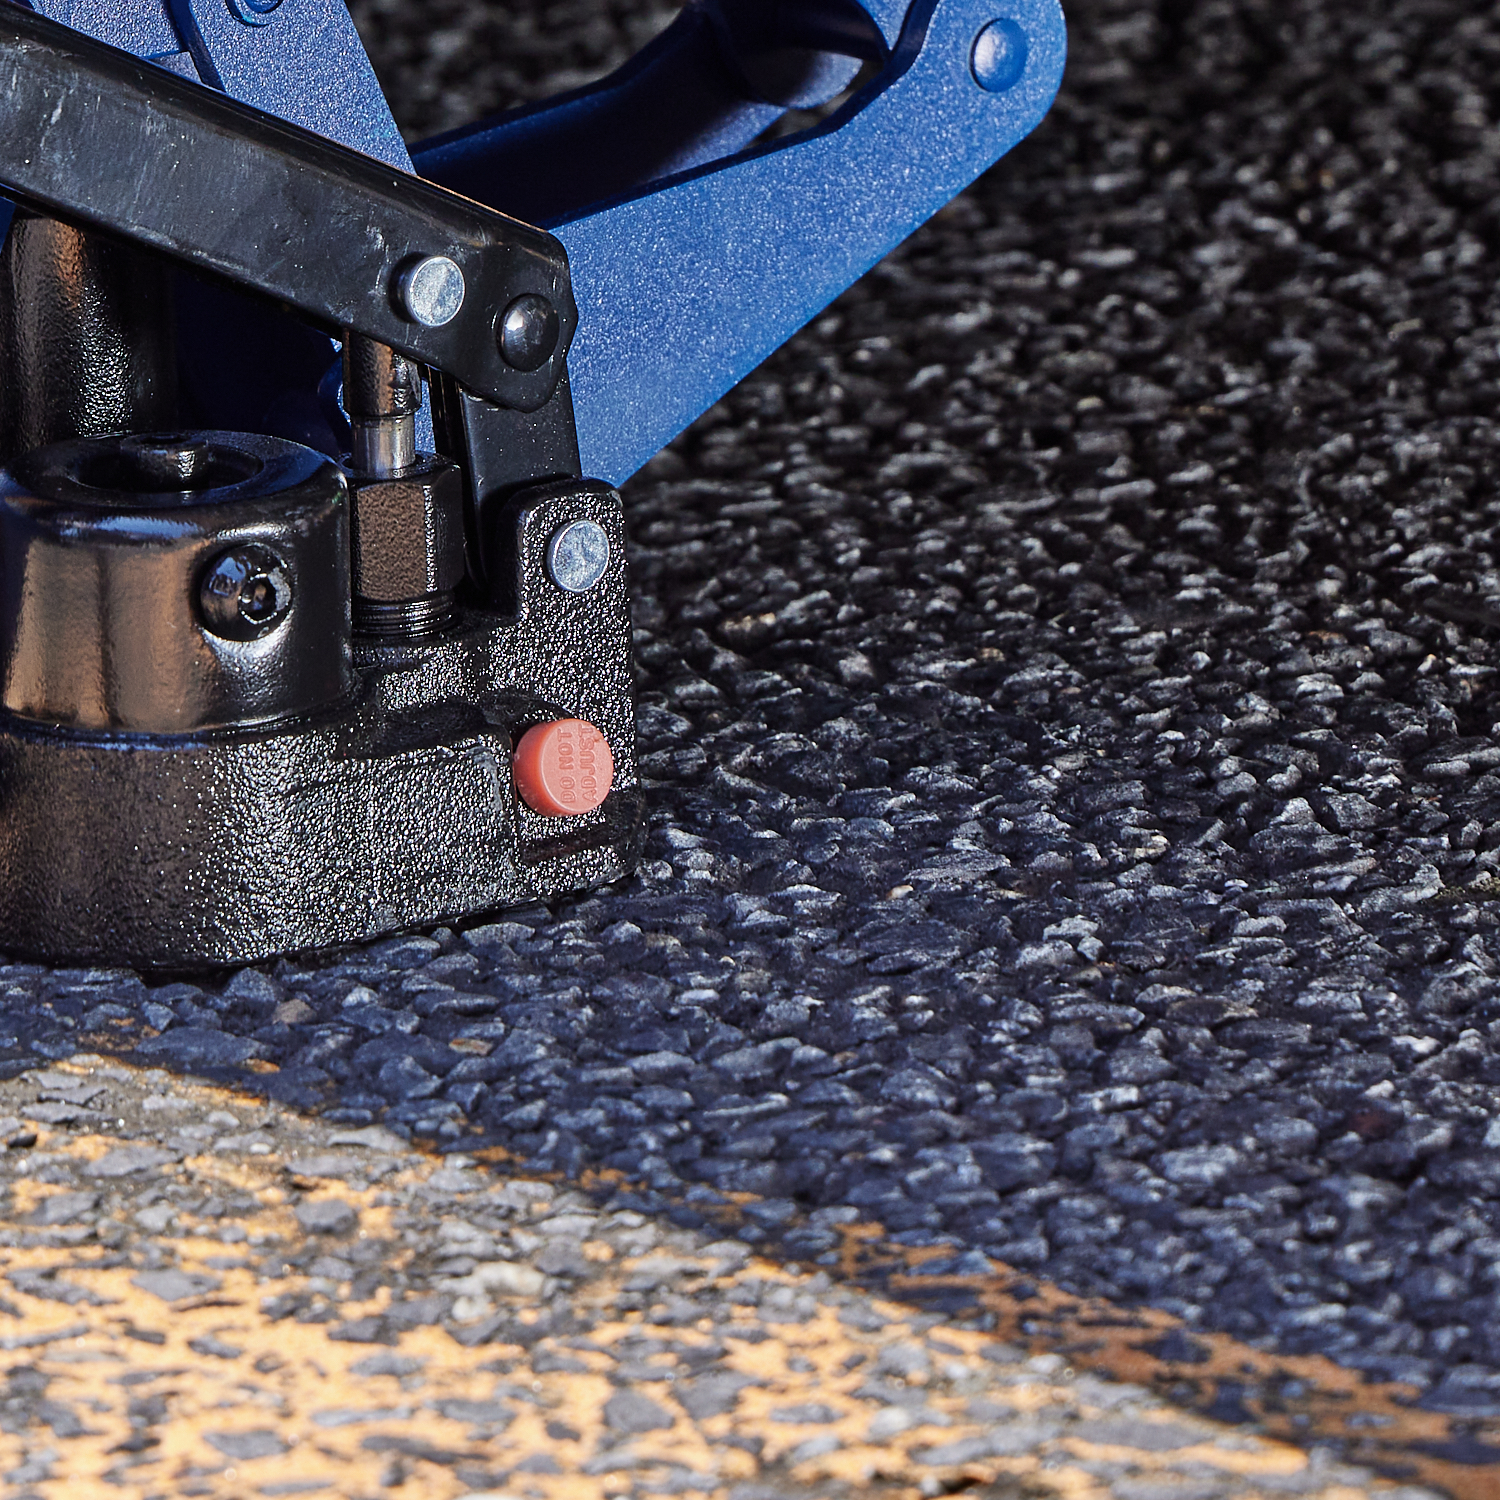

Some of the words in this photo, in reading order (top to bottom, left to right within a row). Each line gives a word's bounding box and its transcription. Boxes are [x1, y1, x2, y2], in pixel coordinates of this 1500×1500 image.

[557, 728, 574, 770] NOT
[578, 723, 599, 803] ADJUST
[560, 777, 576, 803] DO
